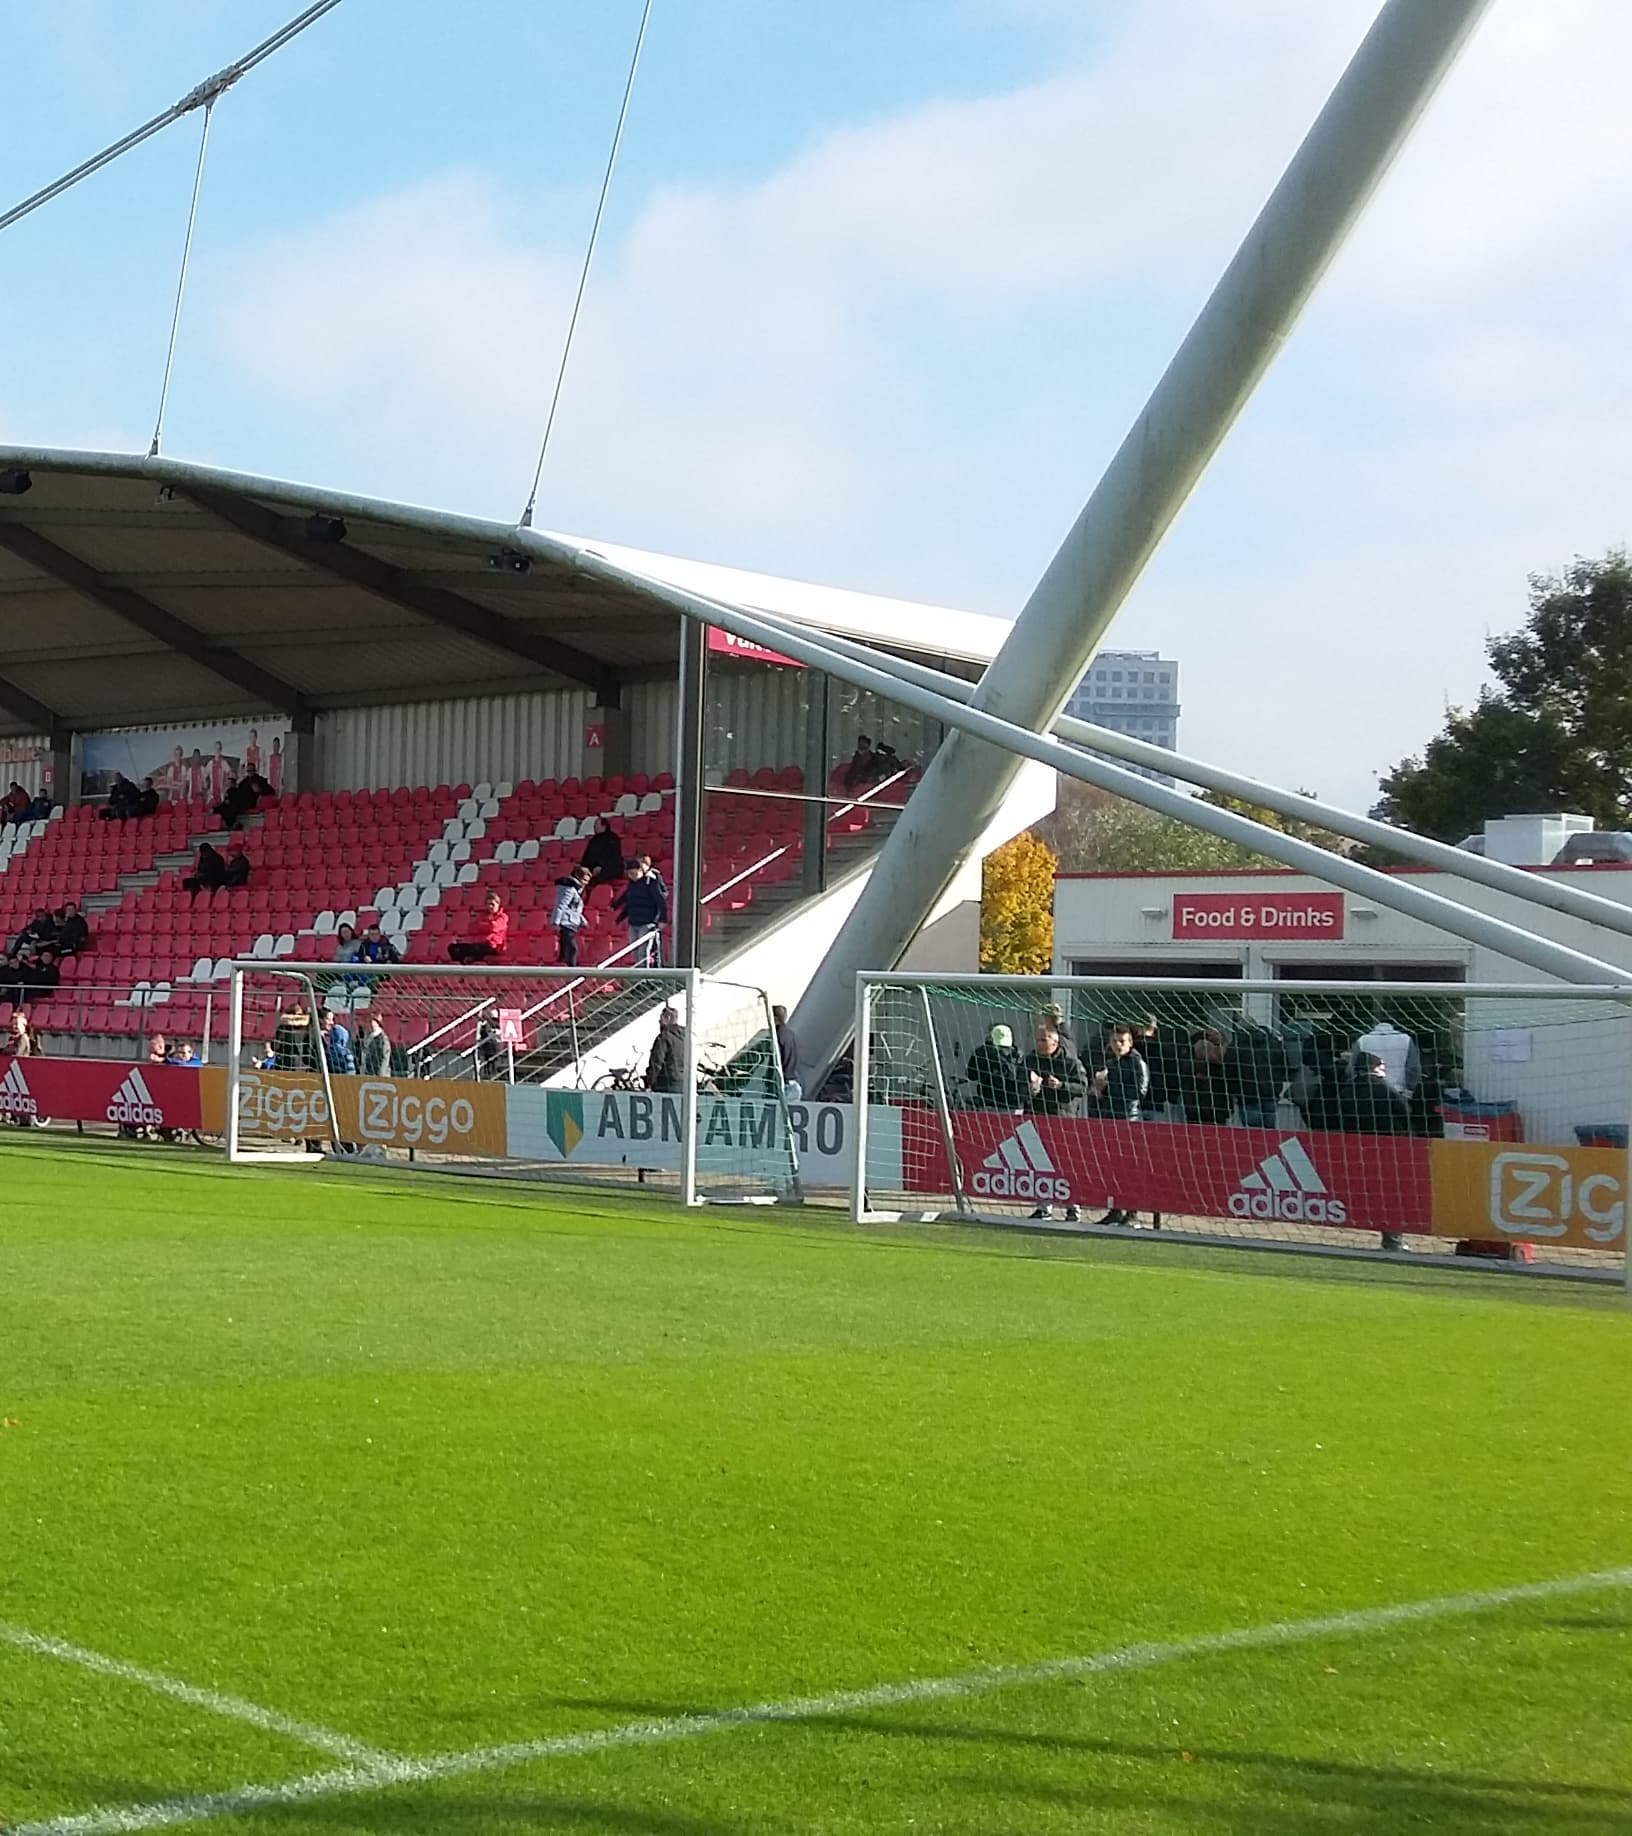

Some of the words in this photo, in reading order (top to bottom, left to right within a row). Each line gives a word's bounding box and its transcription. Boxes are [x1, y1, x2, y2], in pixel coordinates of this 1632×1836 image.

[589, 732, 600, 746] A
[1181, 907, 1235, 927] Food
[1240, 907, 1256, 927] &
[1261, 906, 1335, 927] Drinks
[504, 1019, 519, 1039] A
[106, 1101, 164, 1124] adidas
[358, 1082, 475, 1145] Ziggo
[972, 1168, 1071, 1200] adidas
[1227, 1188, 1347, 1223] adidas
